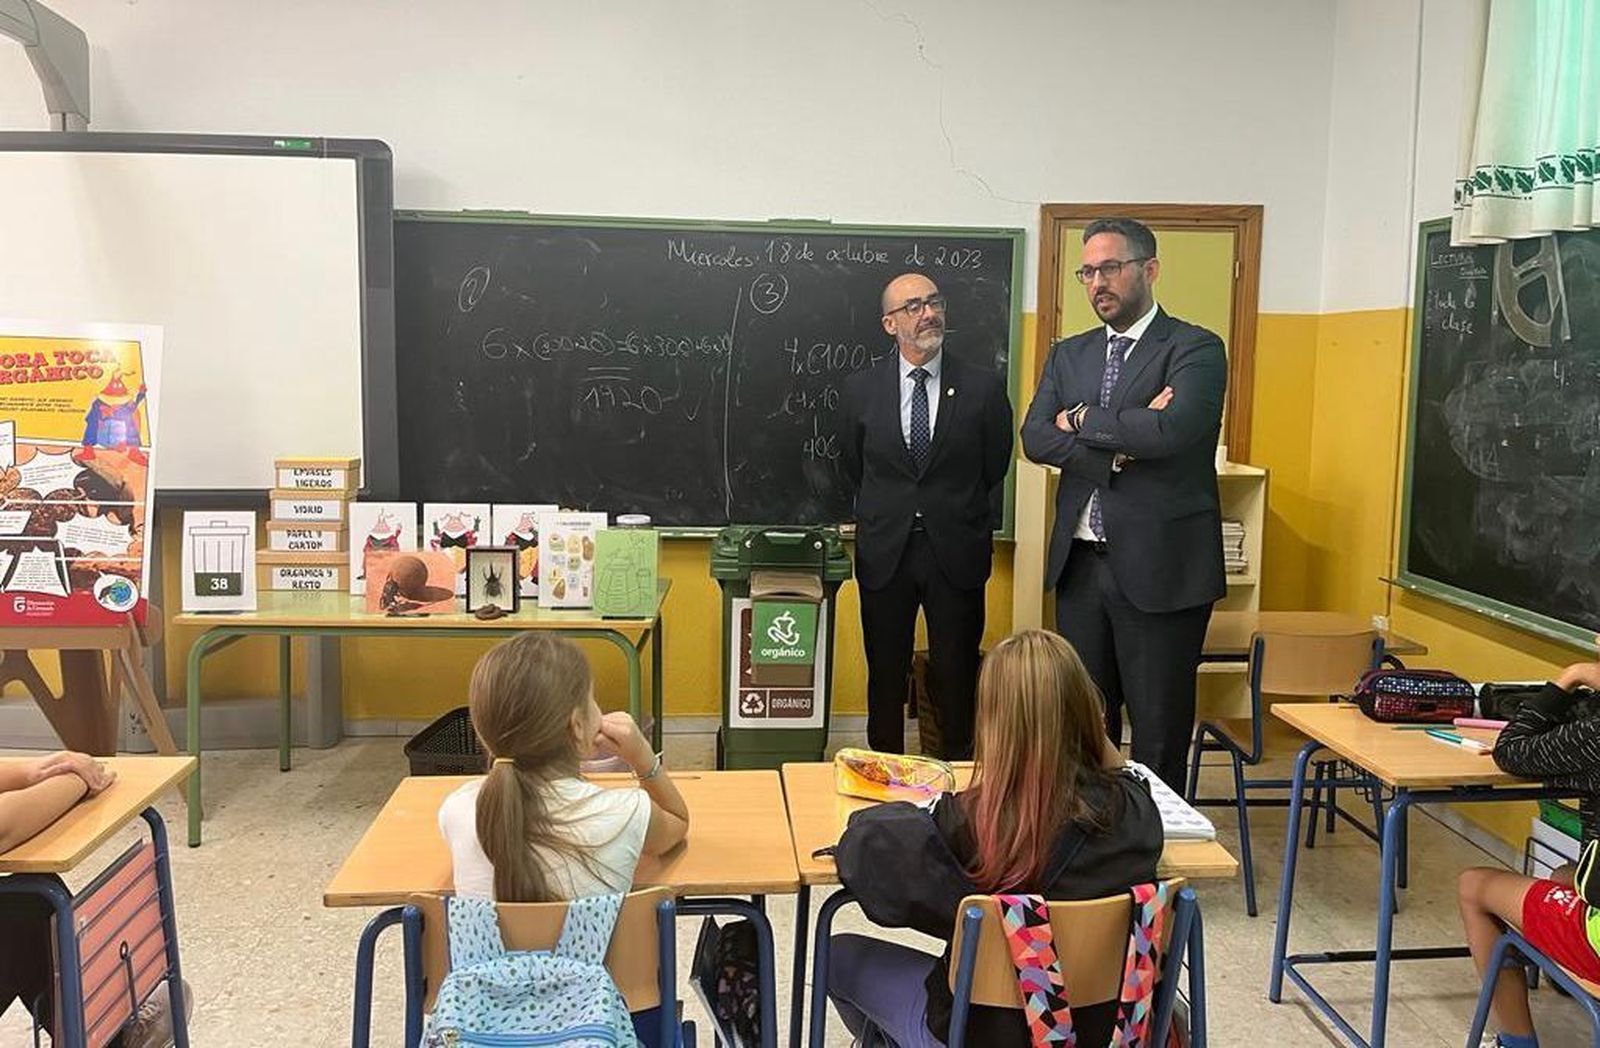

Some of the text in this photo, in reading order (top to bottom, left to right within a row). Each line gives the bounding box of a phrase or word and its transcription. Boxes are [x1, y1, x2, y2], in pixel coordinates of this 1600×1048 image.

[795, 241, 815, 261] de
[903, 243, 926, 267] de
[210, 577, 229, 591] 38
[761, 647, 805, 659] orgánico
